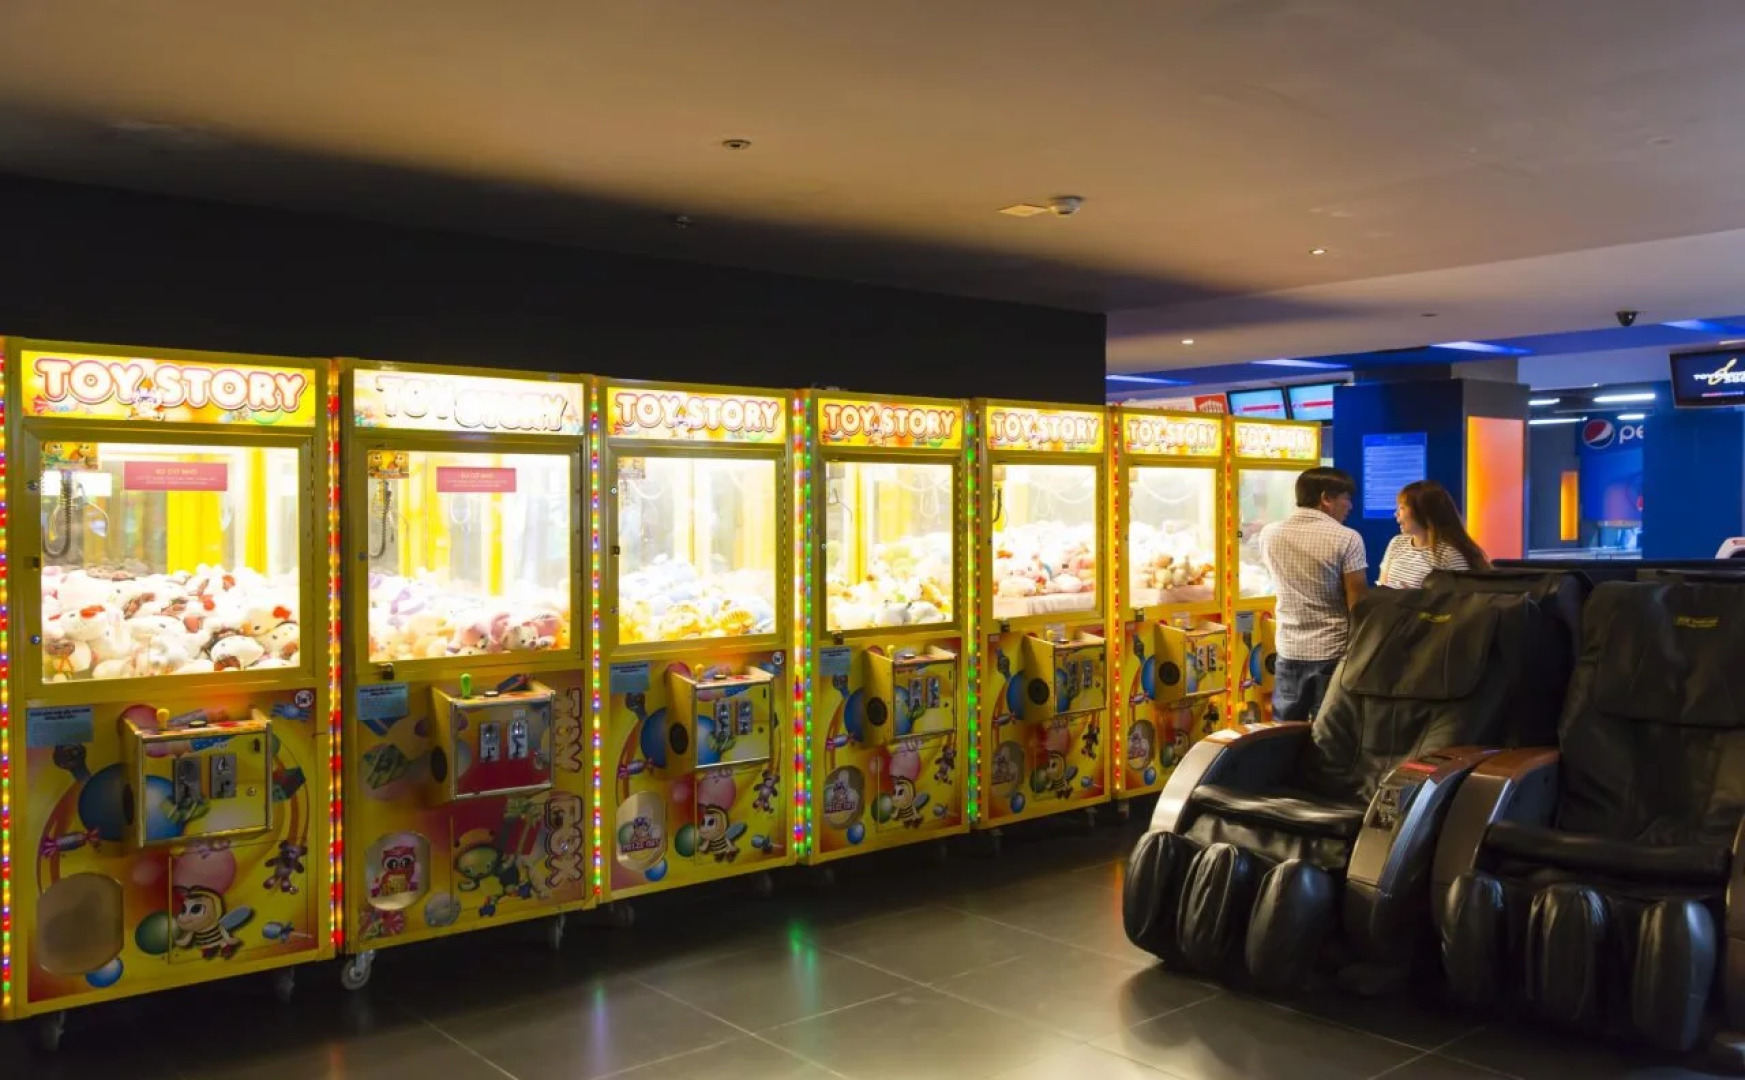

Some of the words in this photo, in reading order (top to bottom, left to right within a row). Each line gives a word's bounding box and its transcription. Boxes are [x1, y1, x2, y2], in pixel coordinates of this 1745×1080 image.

[34, 358, 143, 405] TOY
[153, 364, 309, 412] STORY
[615, 393, 681, 428] TOY
[687, 396, 779, 432] STORY
[824, 404, 876, 436] TOY
[880, 407, 955, 439] STORY
[991, 411, 1034, 442] TOY
[1038, 415, 1099, 444] STORY
[1128, 419, 1162, 446] TOY
